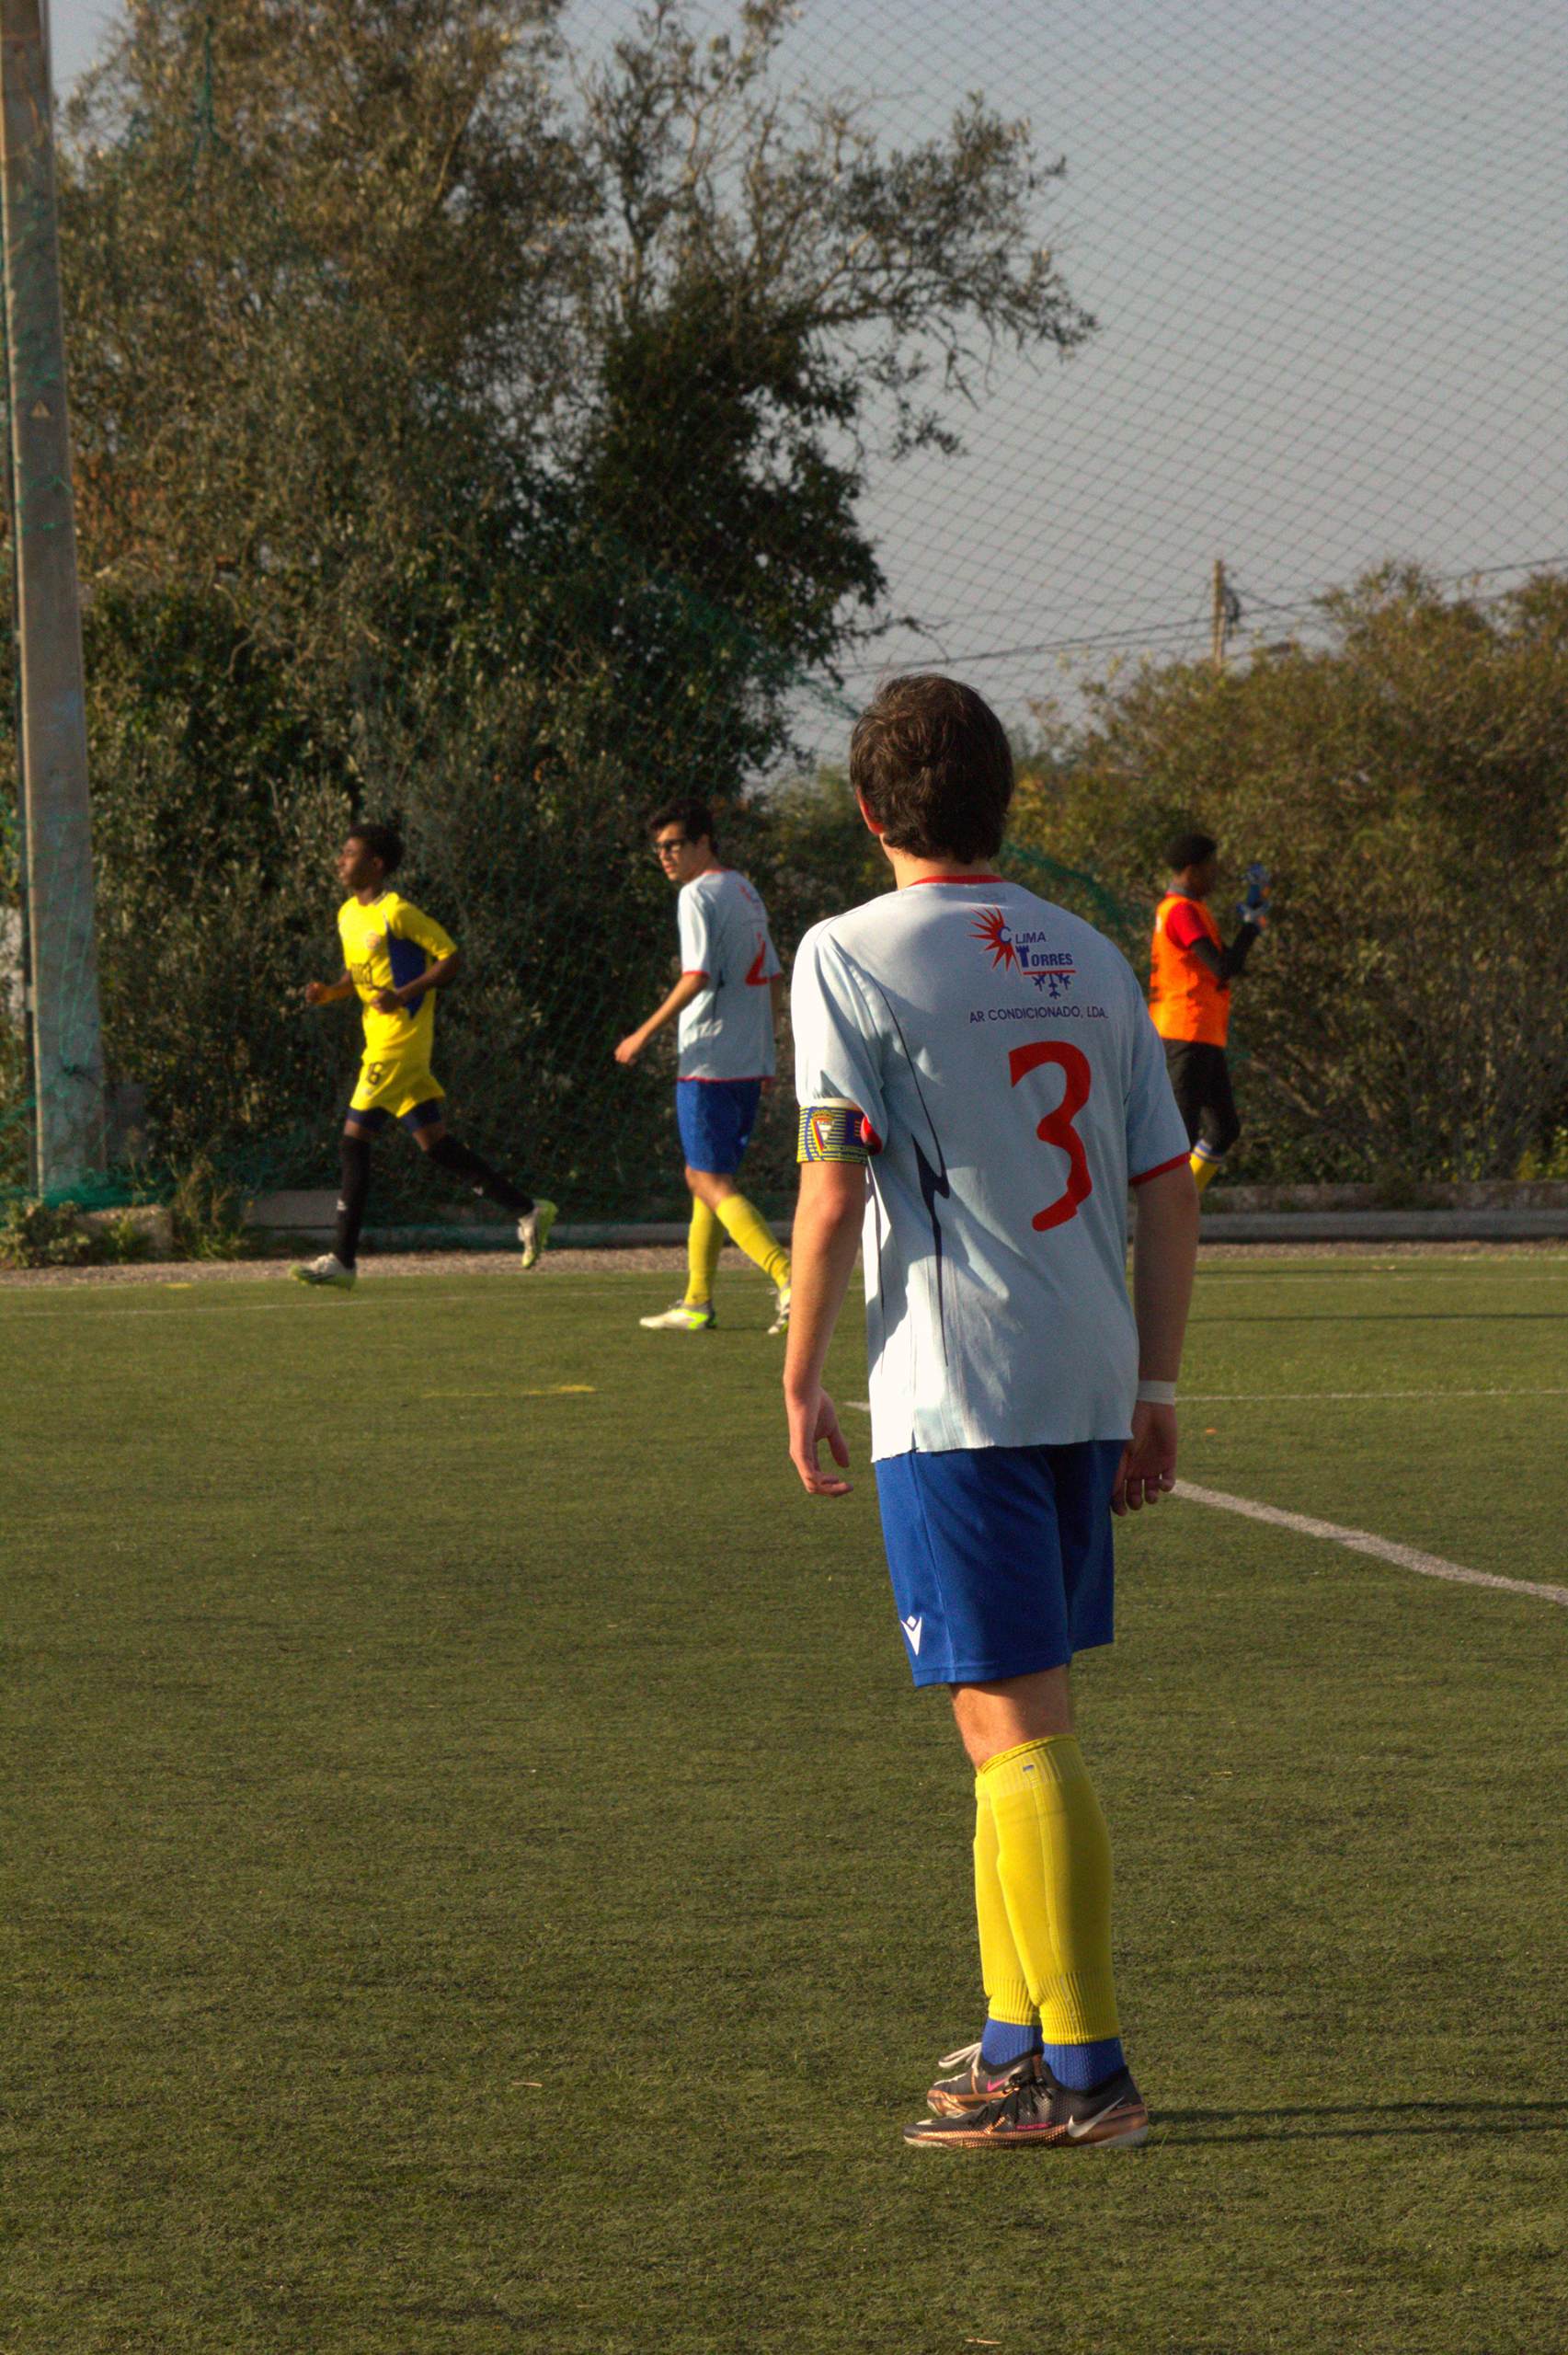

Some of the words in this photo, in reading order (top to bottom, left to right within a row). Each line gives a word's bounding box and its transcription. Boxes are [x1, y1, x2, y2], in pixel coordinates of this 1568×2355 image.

[1015, 945, 1073, 968] TORRES
[969, 1011, 985, 1024] AR
[1008, 1040, 1092, 1231] 3
